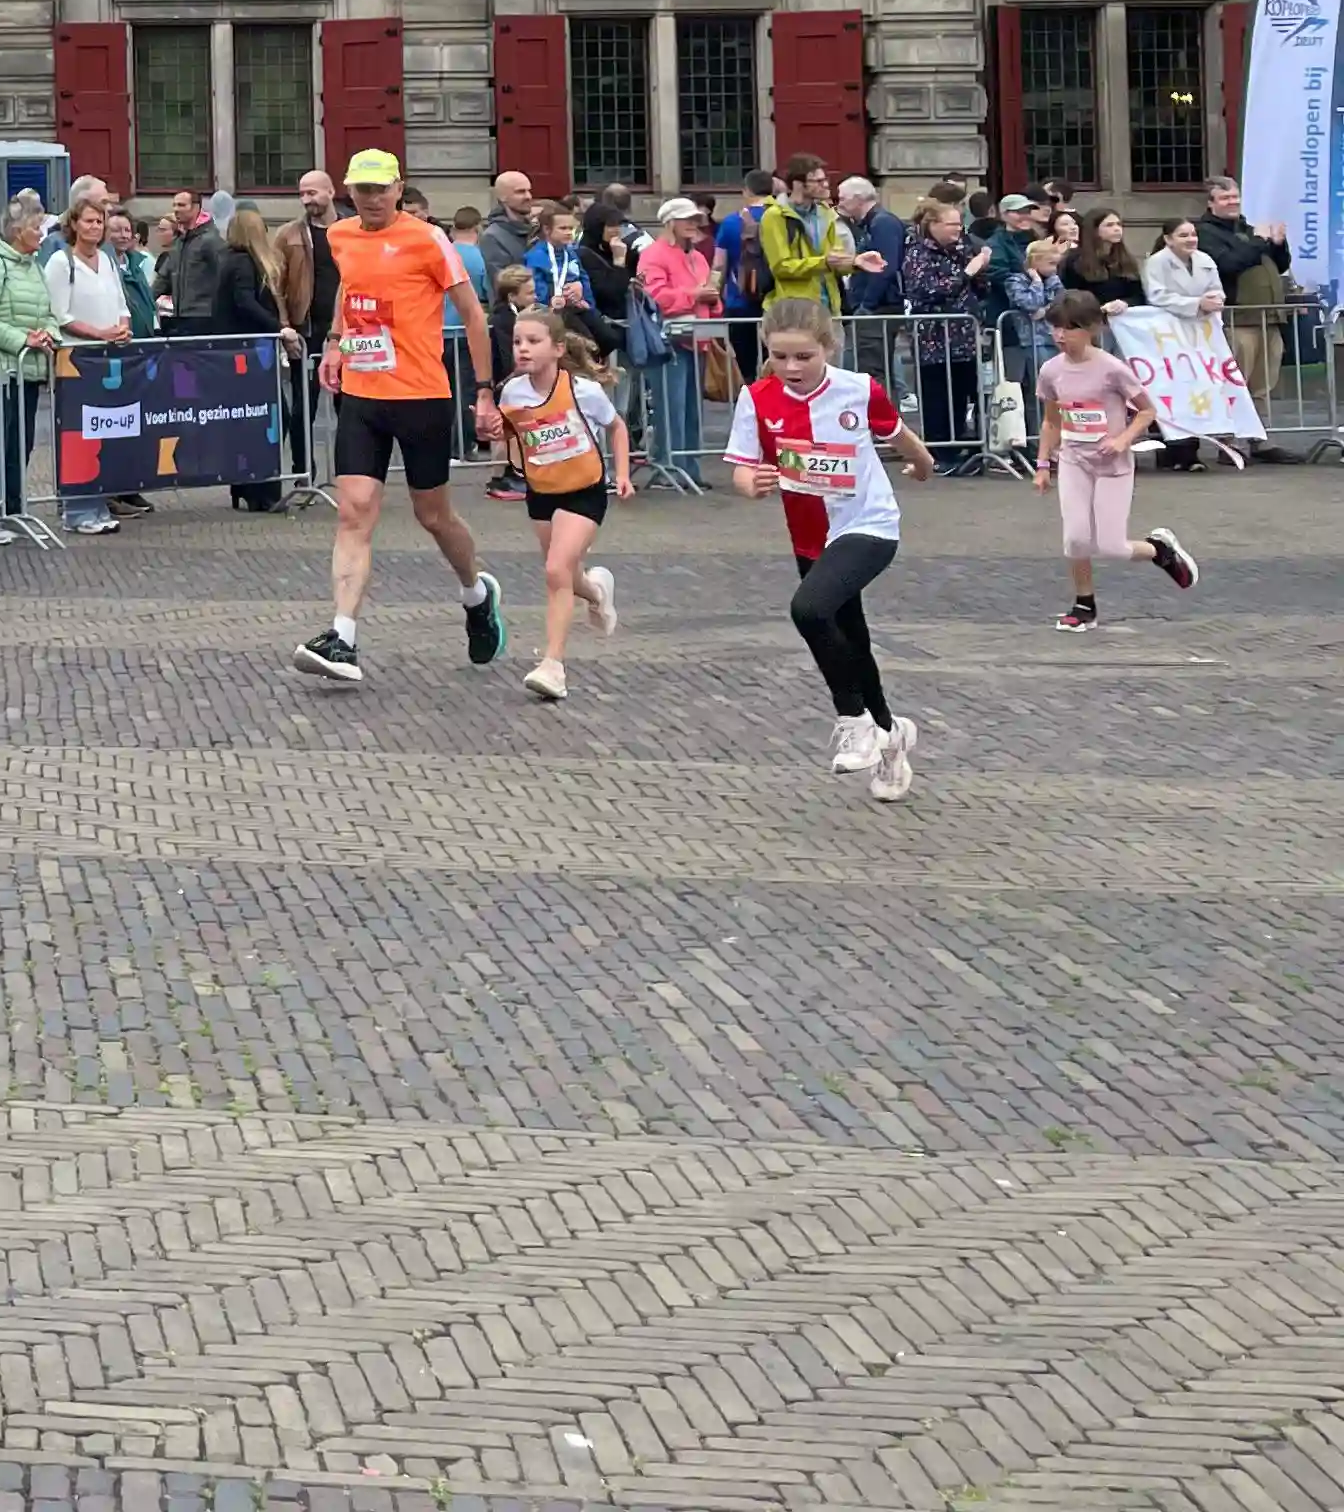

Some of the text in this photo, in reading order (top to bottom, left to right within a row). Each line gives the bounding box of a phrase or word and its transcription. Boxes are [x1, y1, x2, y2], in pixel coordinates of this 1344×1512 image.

[1299, 67, 1329, 260] Kom hardlopen bij
[355, 339, 382, 352] 5014
[90, 413, 135, 431] gro-up
[144, 411, 168, 425] Voor
[198, 404, 230, 425] gezin
[231, 407, 245, 419] en
[807, 457, 849, 473] 2571
